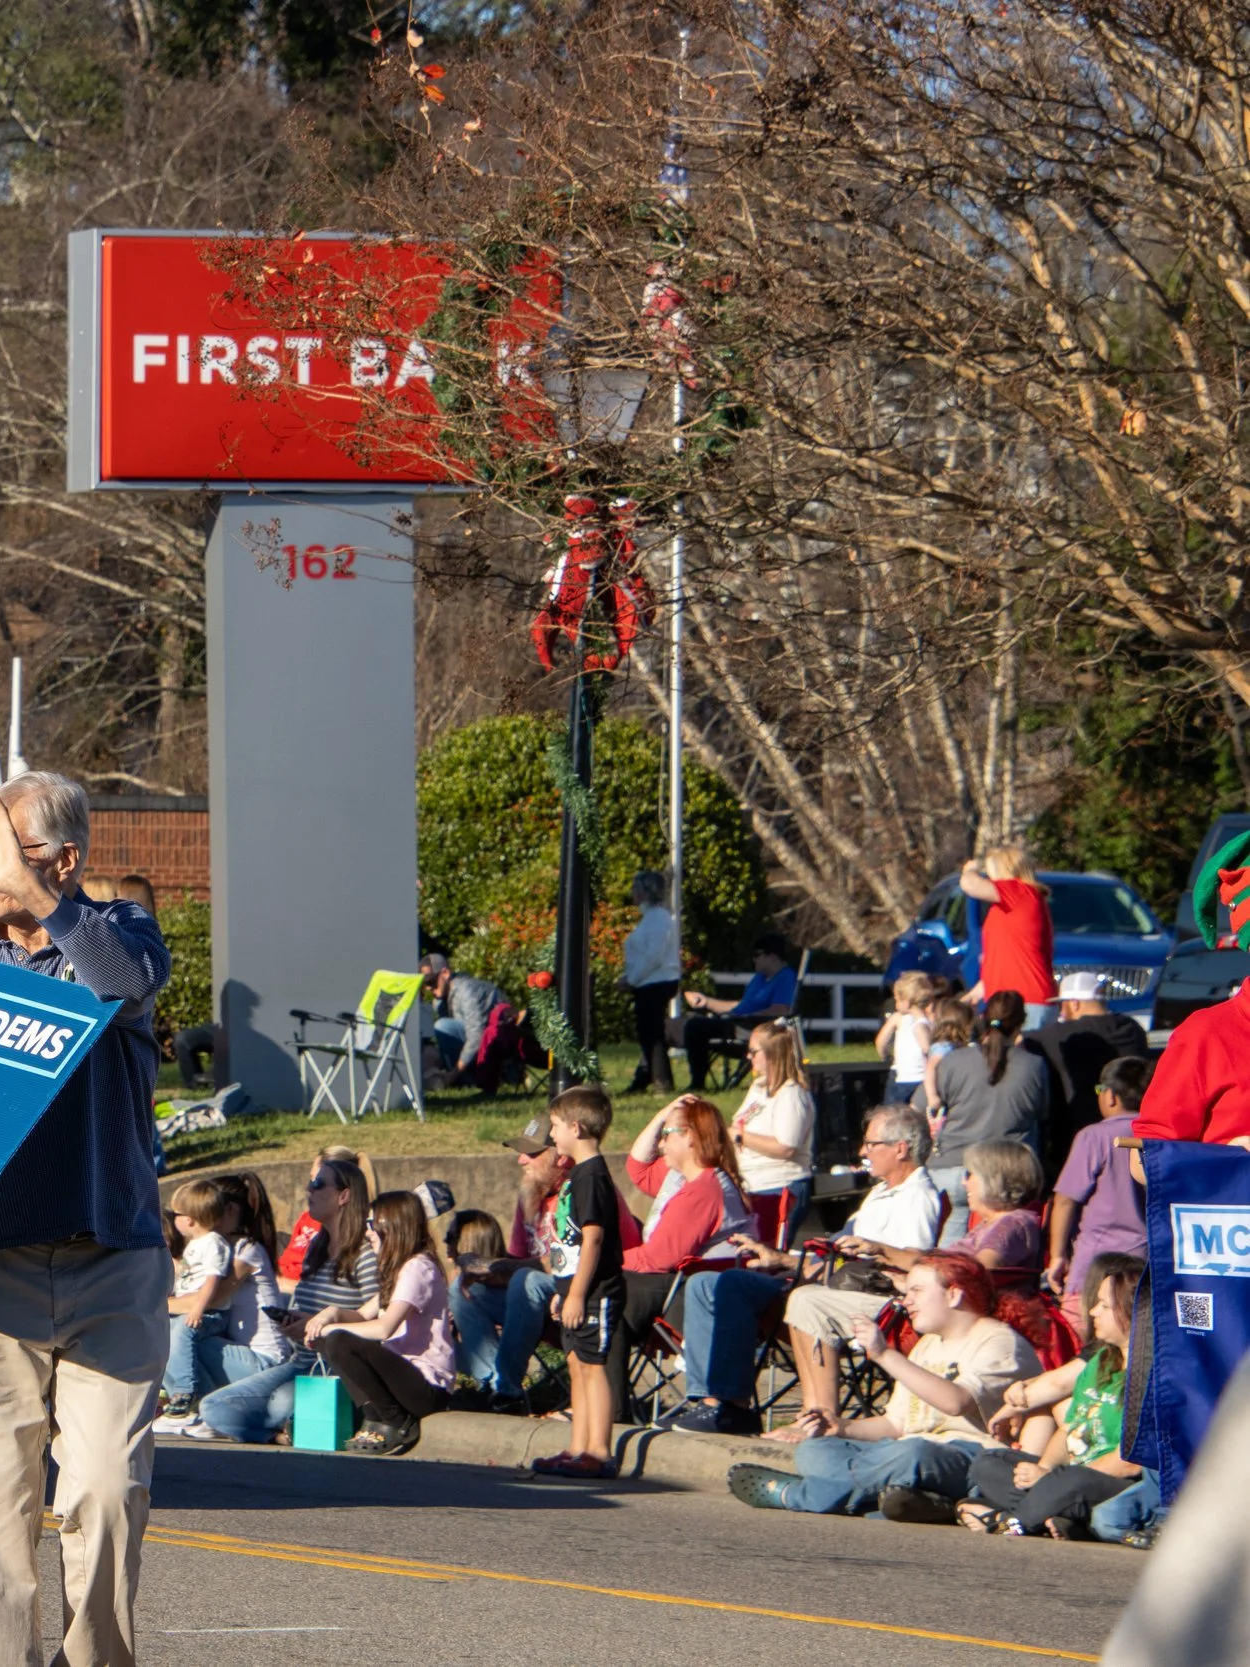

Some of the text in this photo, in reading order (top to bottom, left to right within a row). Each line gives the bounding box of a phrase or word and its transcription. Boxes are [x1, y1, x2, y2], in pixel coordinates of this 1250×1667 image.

[133, 332, 534, 388] FIRST BAK
[281, 543, 357, 580] 162
